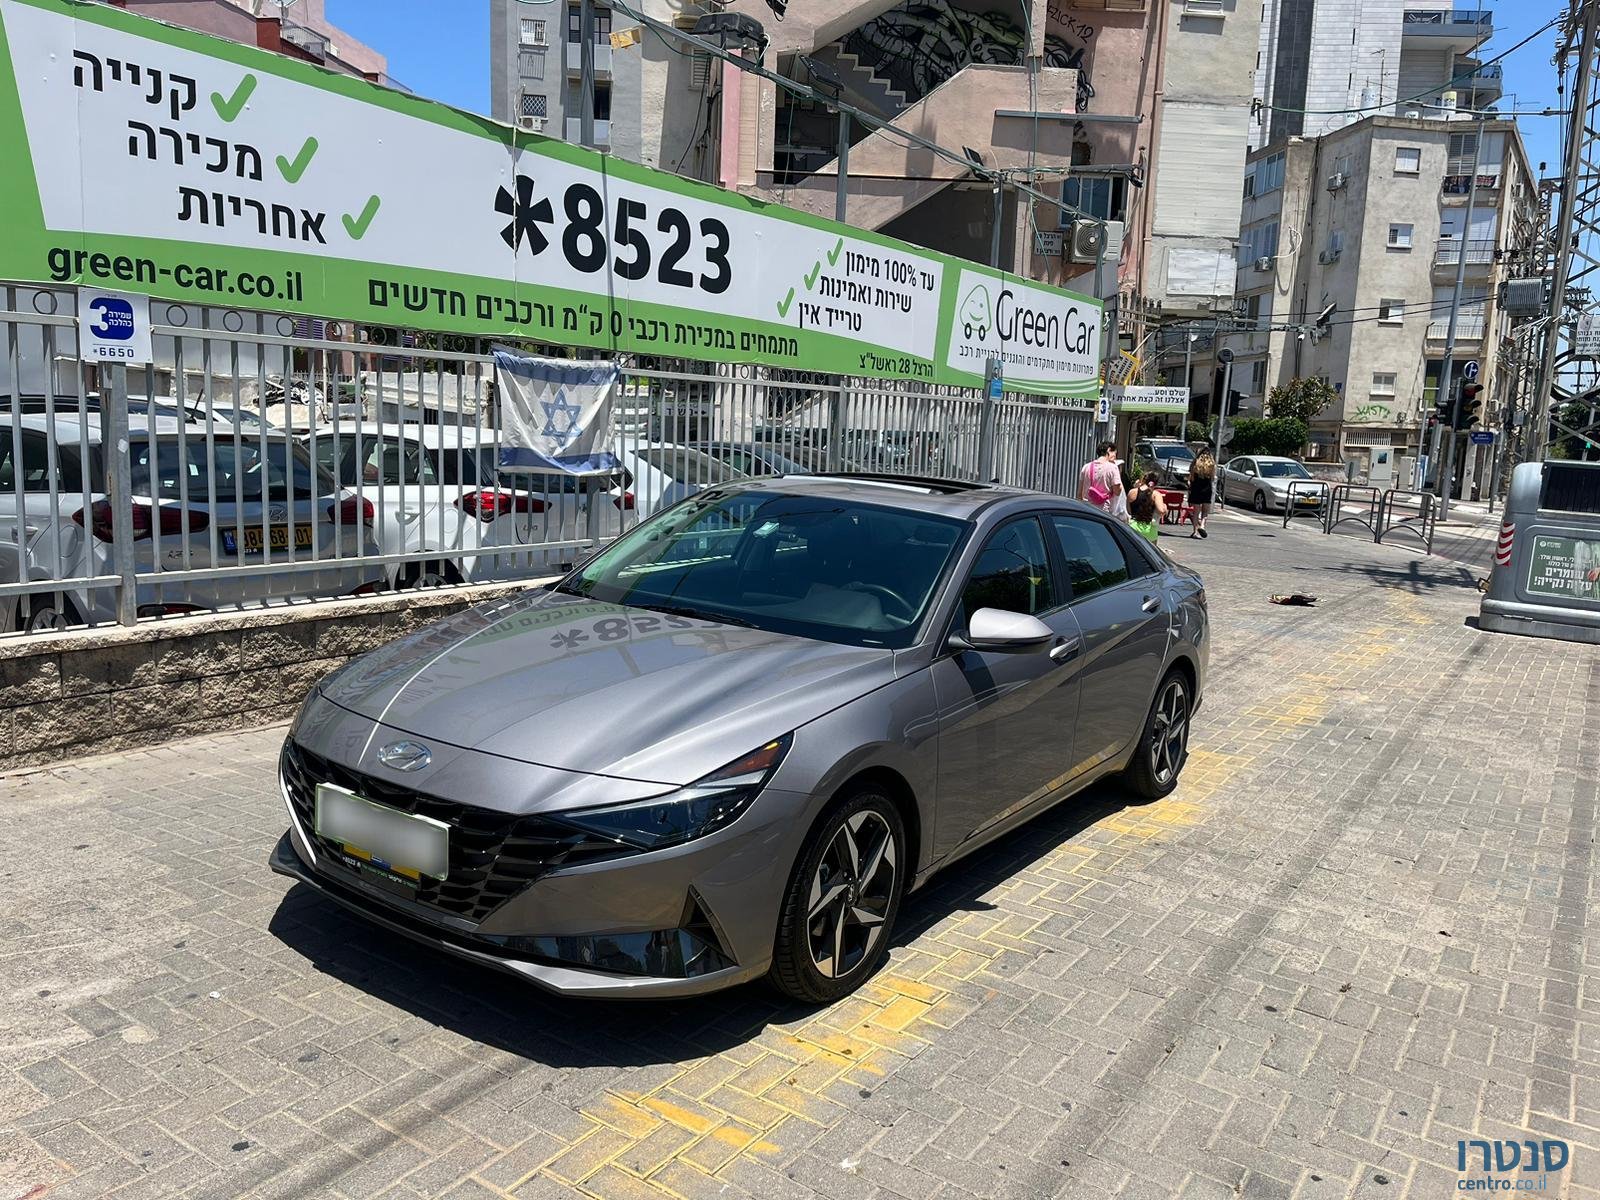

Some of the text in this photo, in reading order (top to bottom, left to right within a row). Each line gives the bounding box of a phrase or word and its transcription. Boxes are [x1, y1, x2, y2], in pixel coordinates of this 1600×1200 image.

[73, 49, 197, 121] קנייה
[128, 120, 263, 181] מכירה
[177, 186, 328, 245] אחריות
[47, 246, 303, 302] green-car.co.il
[846, 251, 935, 291] עד 100% מימון
[368, 279, 466, 317] חדשים
[820, 275, 912, 313] שירות ואמינות
[108, 311, 132, 319] שמירה
[108, 318, 133, 327] כהלכה
[476, 294, 554, 328] ורכבים
[610, 310, 623, 337] 0
[799, 302, 862, 332] טרייד אין
[995, 289, 1095, 355] Green Car
[628, 317, 669, 343] רכבי
[674, 323, 736, 350] במכירת
[740, 331, 798, 357] מתמחים
[959, 345, 973, 358] רכב
[898, 358, 911, 374] 28
[912, 359, 934, 378] הרצל
[1027, 356, 1055, 371] מתקדמים
[1534, 576, 1565, 588] נקייה!
[1545, 567, 1585, 579] שומרים
